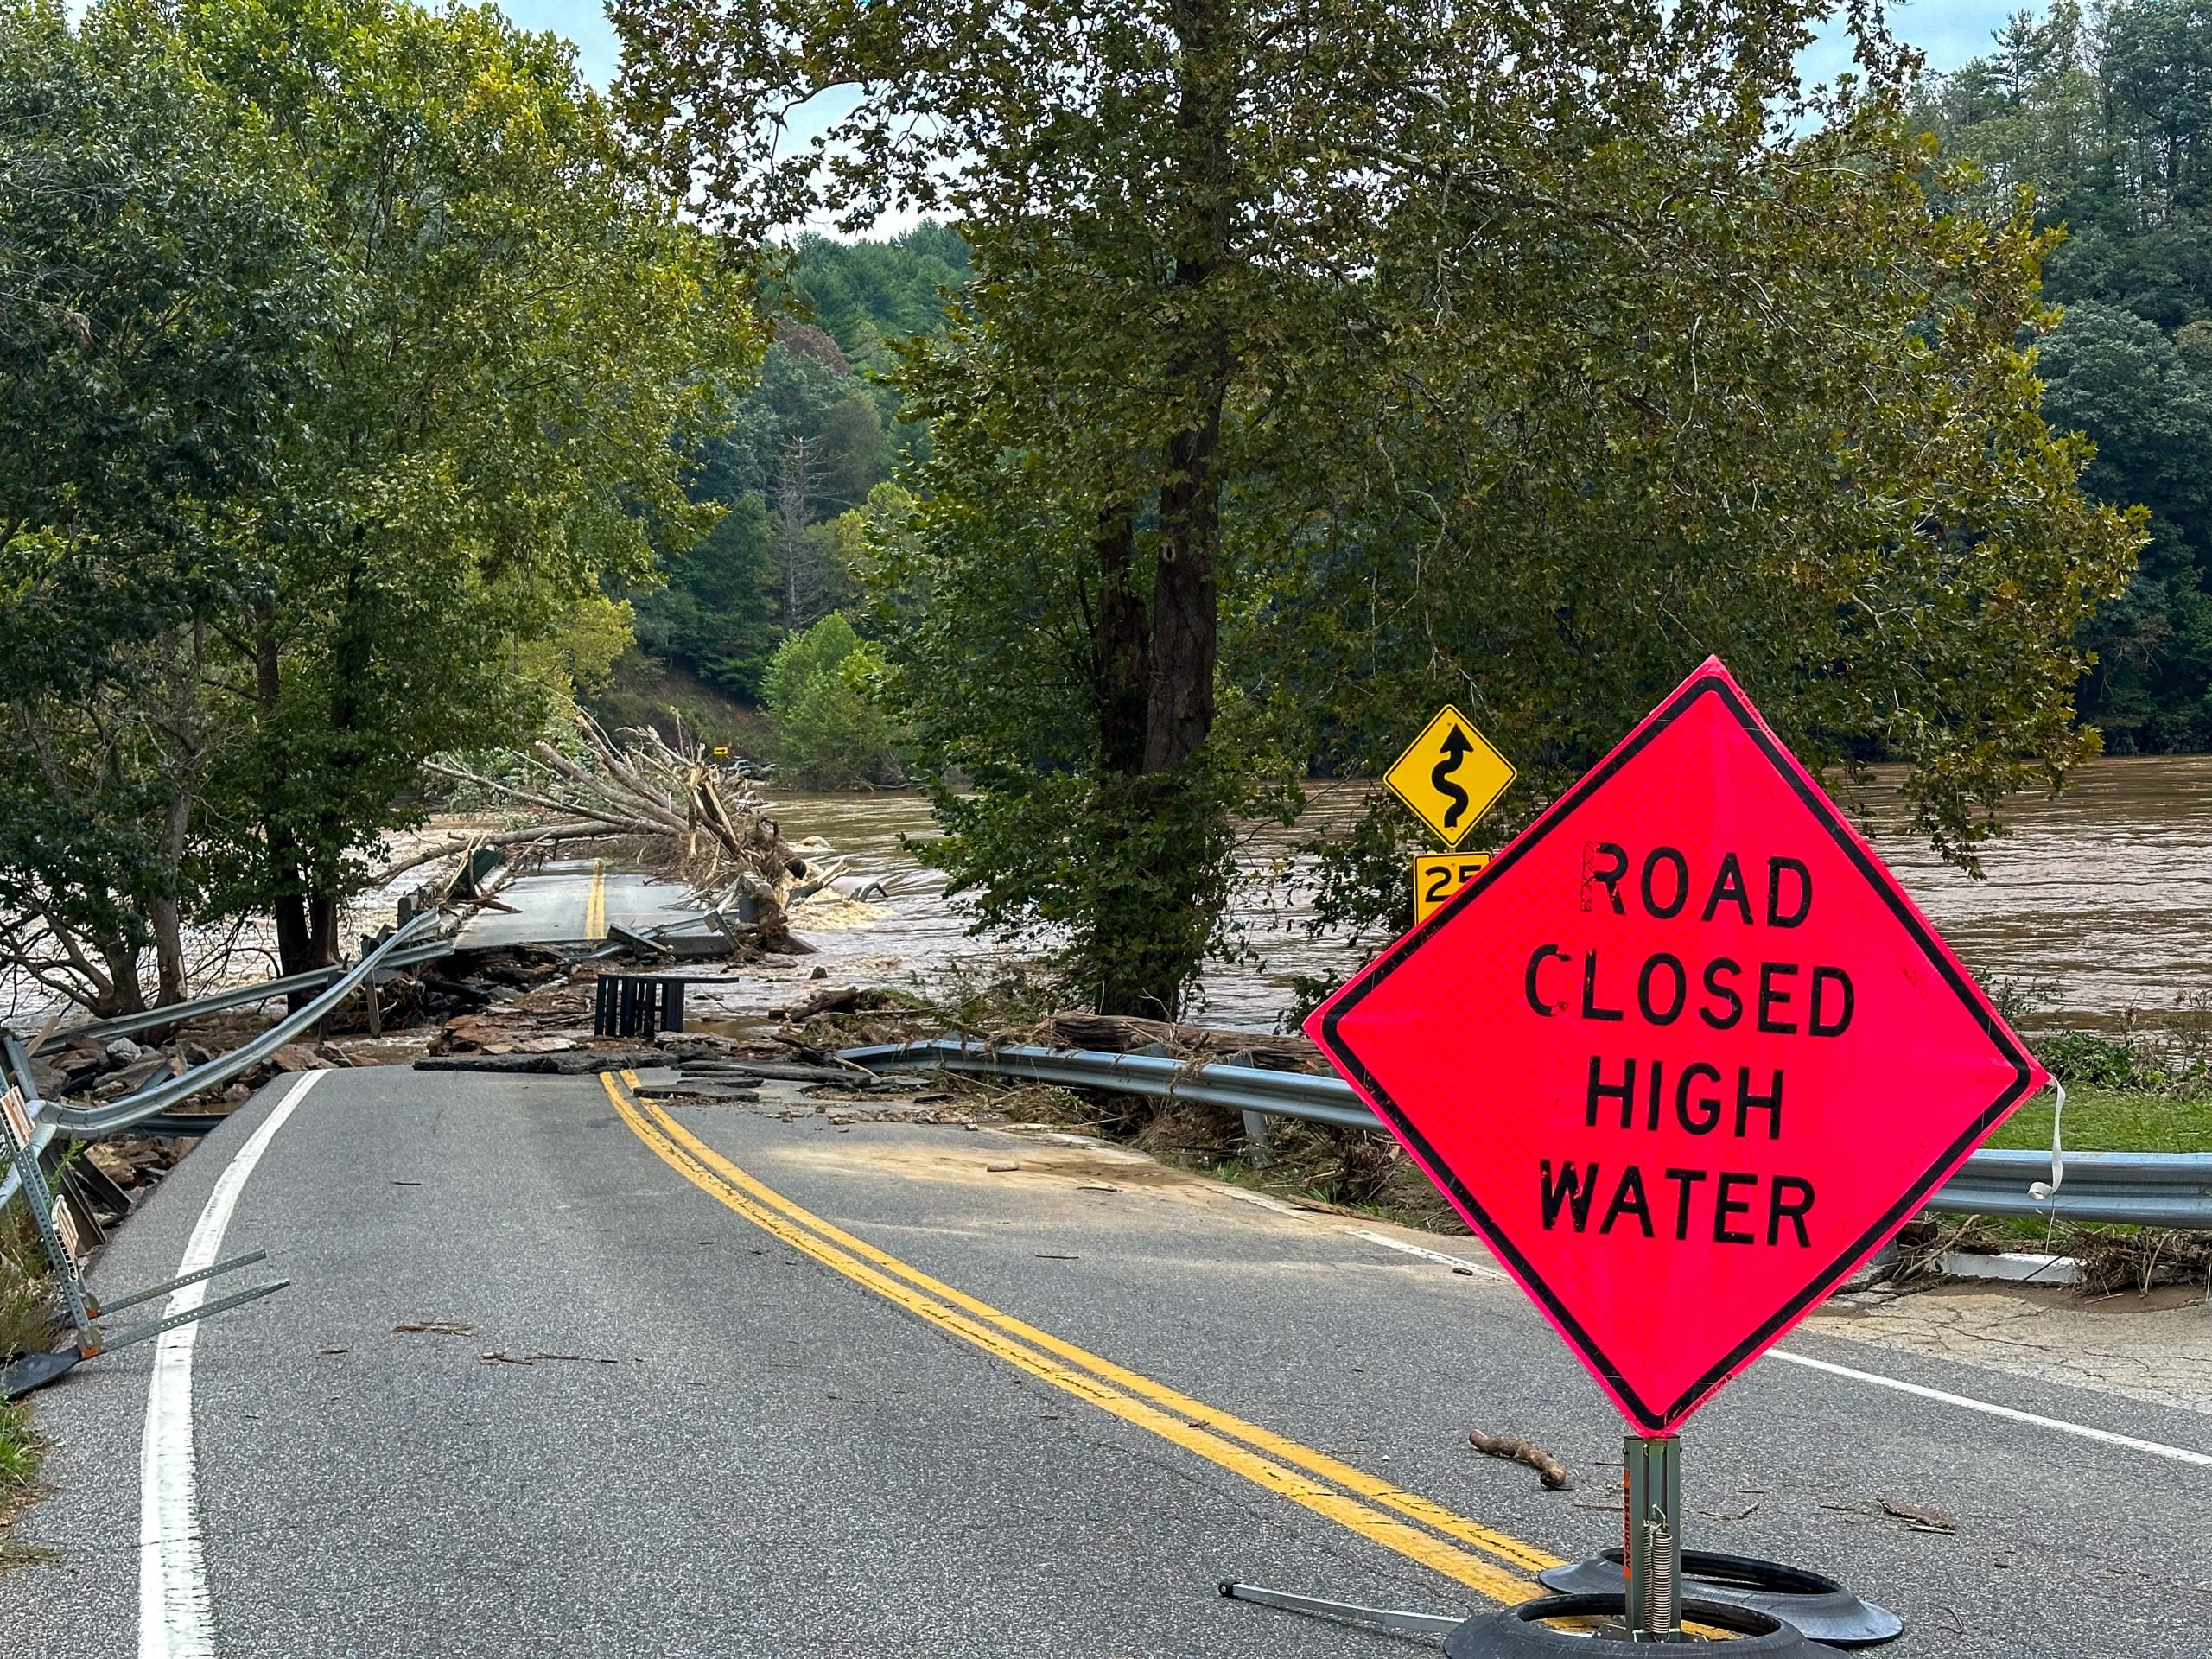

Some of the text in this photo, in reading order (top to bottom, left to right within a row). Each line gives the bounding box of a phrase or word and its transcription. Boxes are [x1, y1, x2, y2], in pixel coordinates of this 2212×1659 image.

[1580, 842, 1813, 929] ROAD
[1525, 944, 1855, 1038] CLOSED
[1585, 1055, 1784, 1141] HIGH
[1540, 1159, 1815, 1249] WATER
